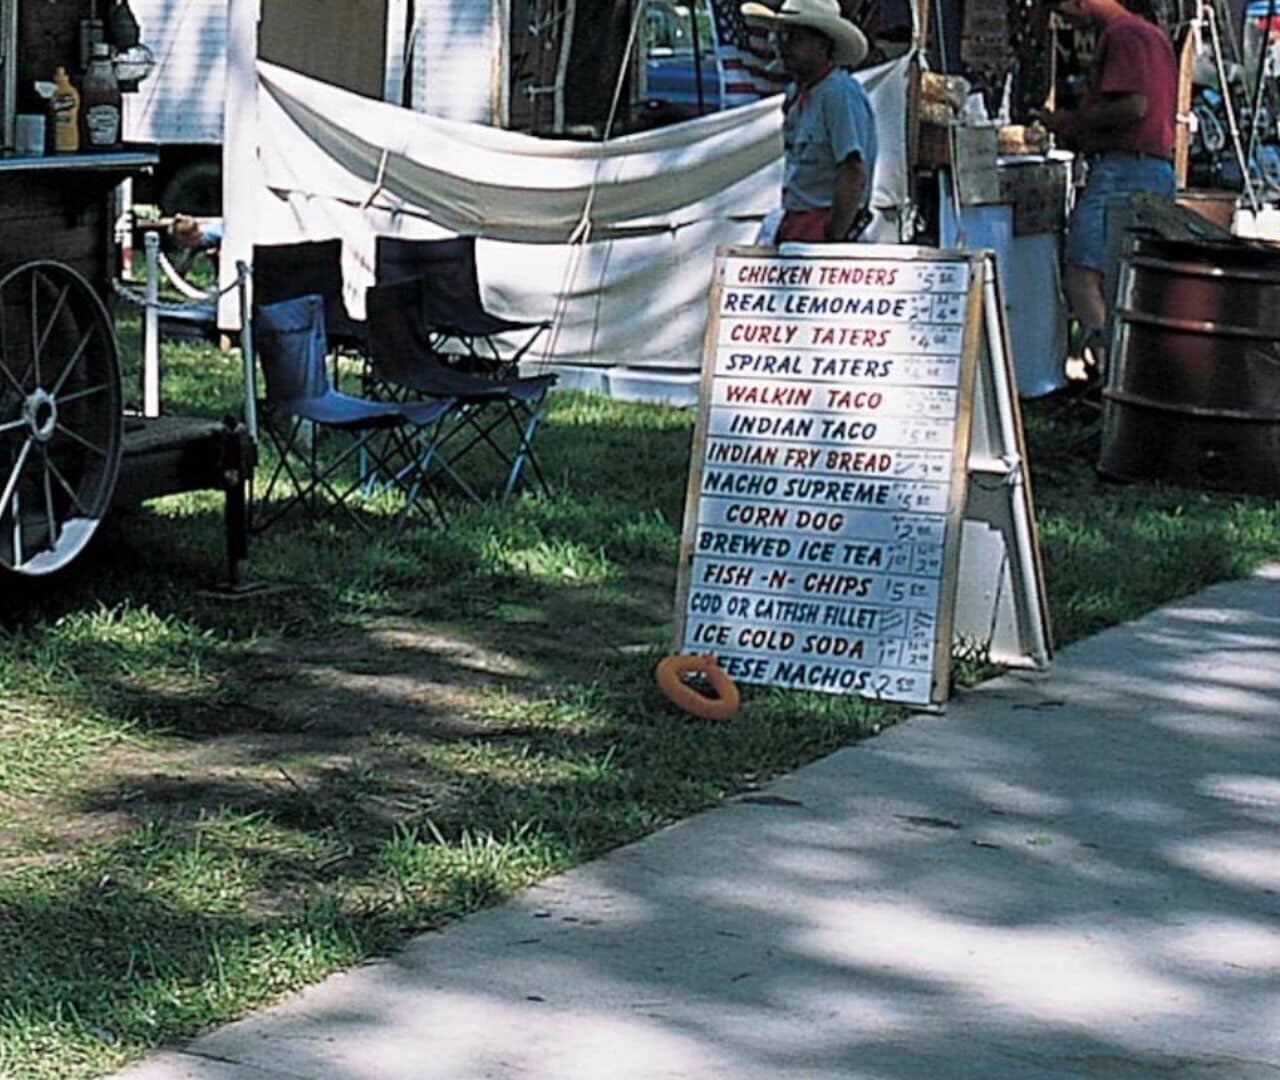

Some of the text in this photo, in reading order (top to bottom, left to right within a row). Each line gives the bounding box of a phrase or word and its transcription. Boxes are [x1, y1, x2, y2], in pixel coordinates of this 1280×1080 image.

[738, 266, 811, 285] CHICKEN
[819, 268, 899, 287] TENDERS
[724, 293, 777, 313] REAL
[784, 294, 907, 318] LEMONADE
[730, 324, 798, 344] CURLY
[812, 327, 891, 348] TATERS
[726, 353, 802, 374] SPIRAL
[812, 357, 893, 377] TATERS
[726, 385, 812, 407] WALKIN
[827, 389, 882, 409] TACO
[729, 414, 811, 437] INDIAN
[822, 418, 877, 439] TACO
[707, 442, 777, 464] INDIAN
[785, 445, 820, 468] FRY
[825, 450, 893, 473] BREAD
[704, 472, 778, 495] NACHO
[783, 478, 891, 505] SUPREME
[726, 505, 843, 532] CORN DOG
[698, 532, 790, 558] BREWED
[798, 540, 834, 563] ICE
[843, 545, 882, 567] TEA
[703, 563, 752, 587] FISH
[761, 569, 795, 589] -N-
[803, 573, 873, 597] CHIPS
[691, 592, 879, 630] COD OR CATFISH FILLET
[694, 623, 732, 645] ICE
[738, 628, 795, 652] COLD
[802, 635, 865, 659] SODA
[777, 662, 870, 691] NACHOS
